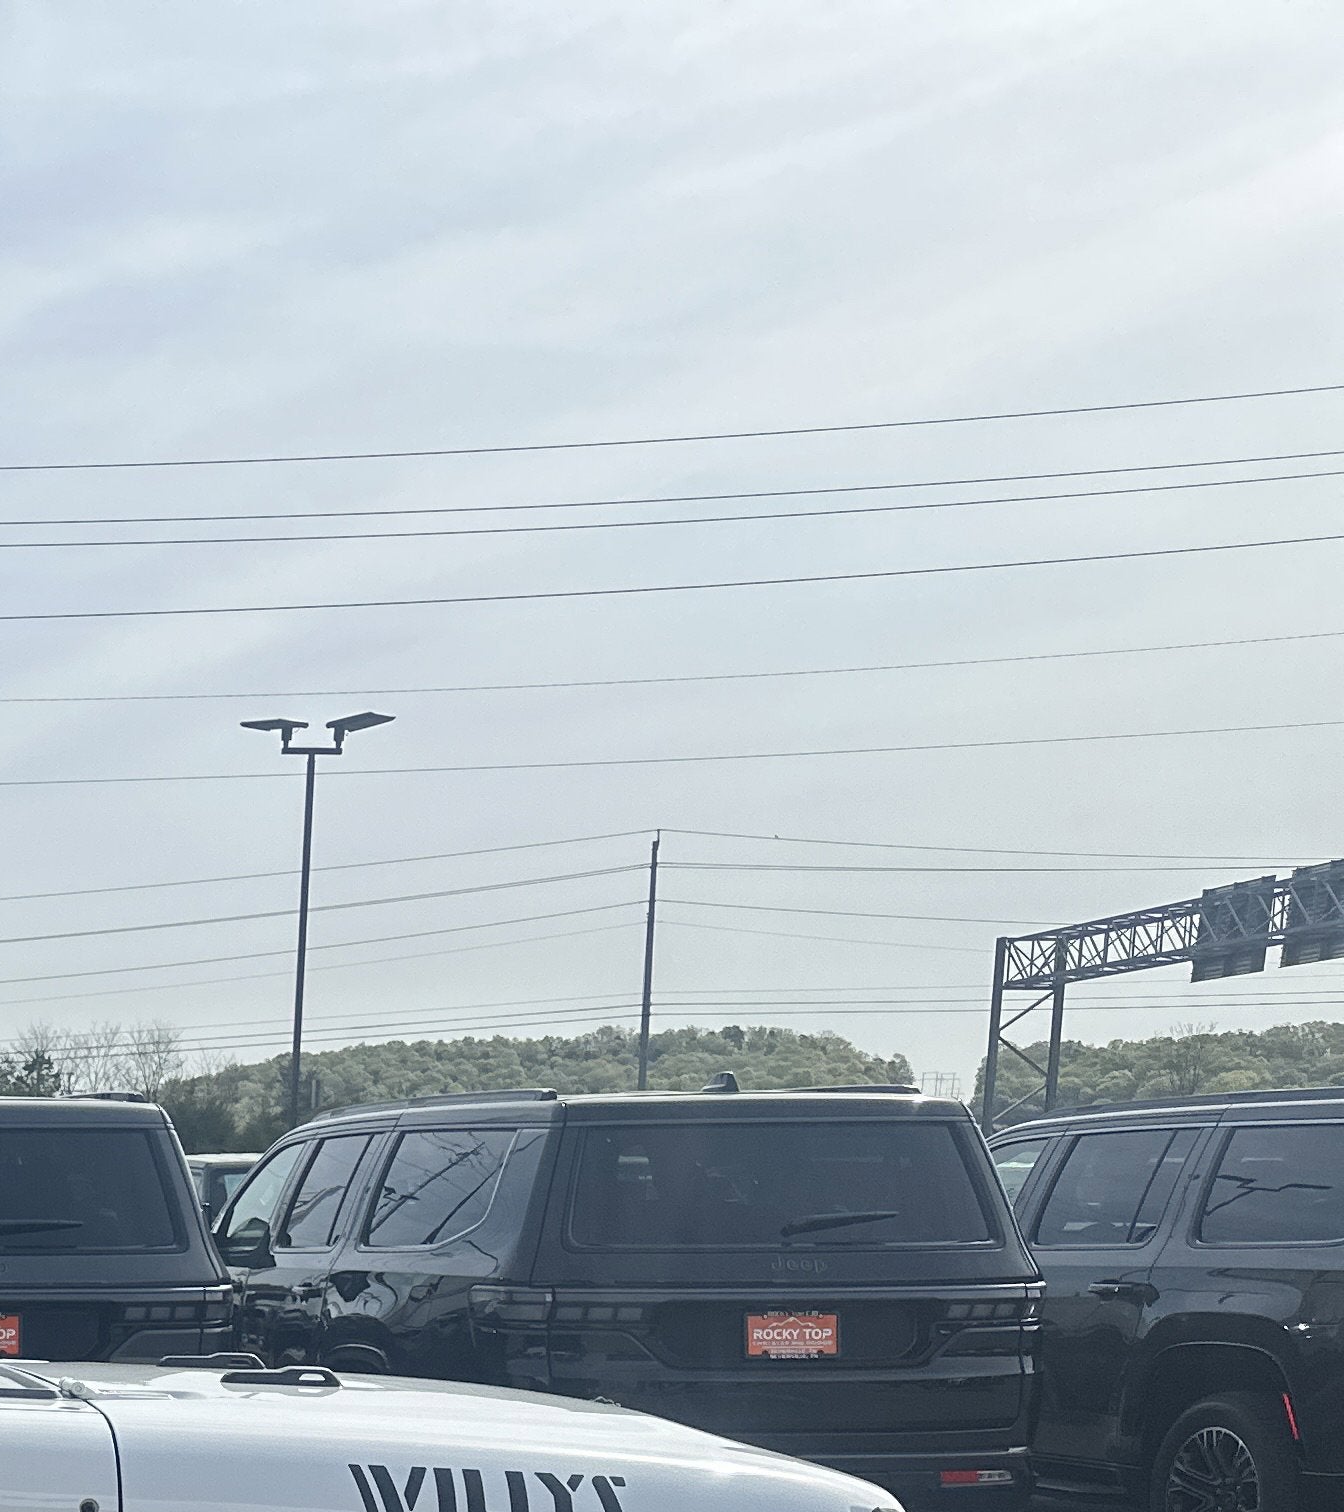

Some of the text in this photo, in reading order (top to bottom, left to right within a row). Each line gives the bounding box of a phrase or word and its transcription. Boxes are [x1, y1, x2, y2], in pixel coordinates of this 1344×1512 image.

[771, 1255, 828, 1273] Jeep
[753, 1328, 832, 1339] ROCKY TOP
